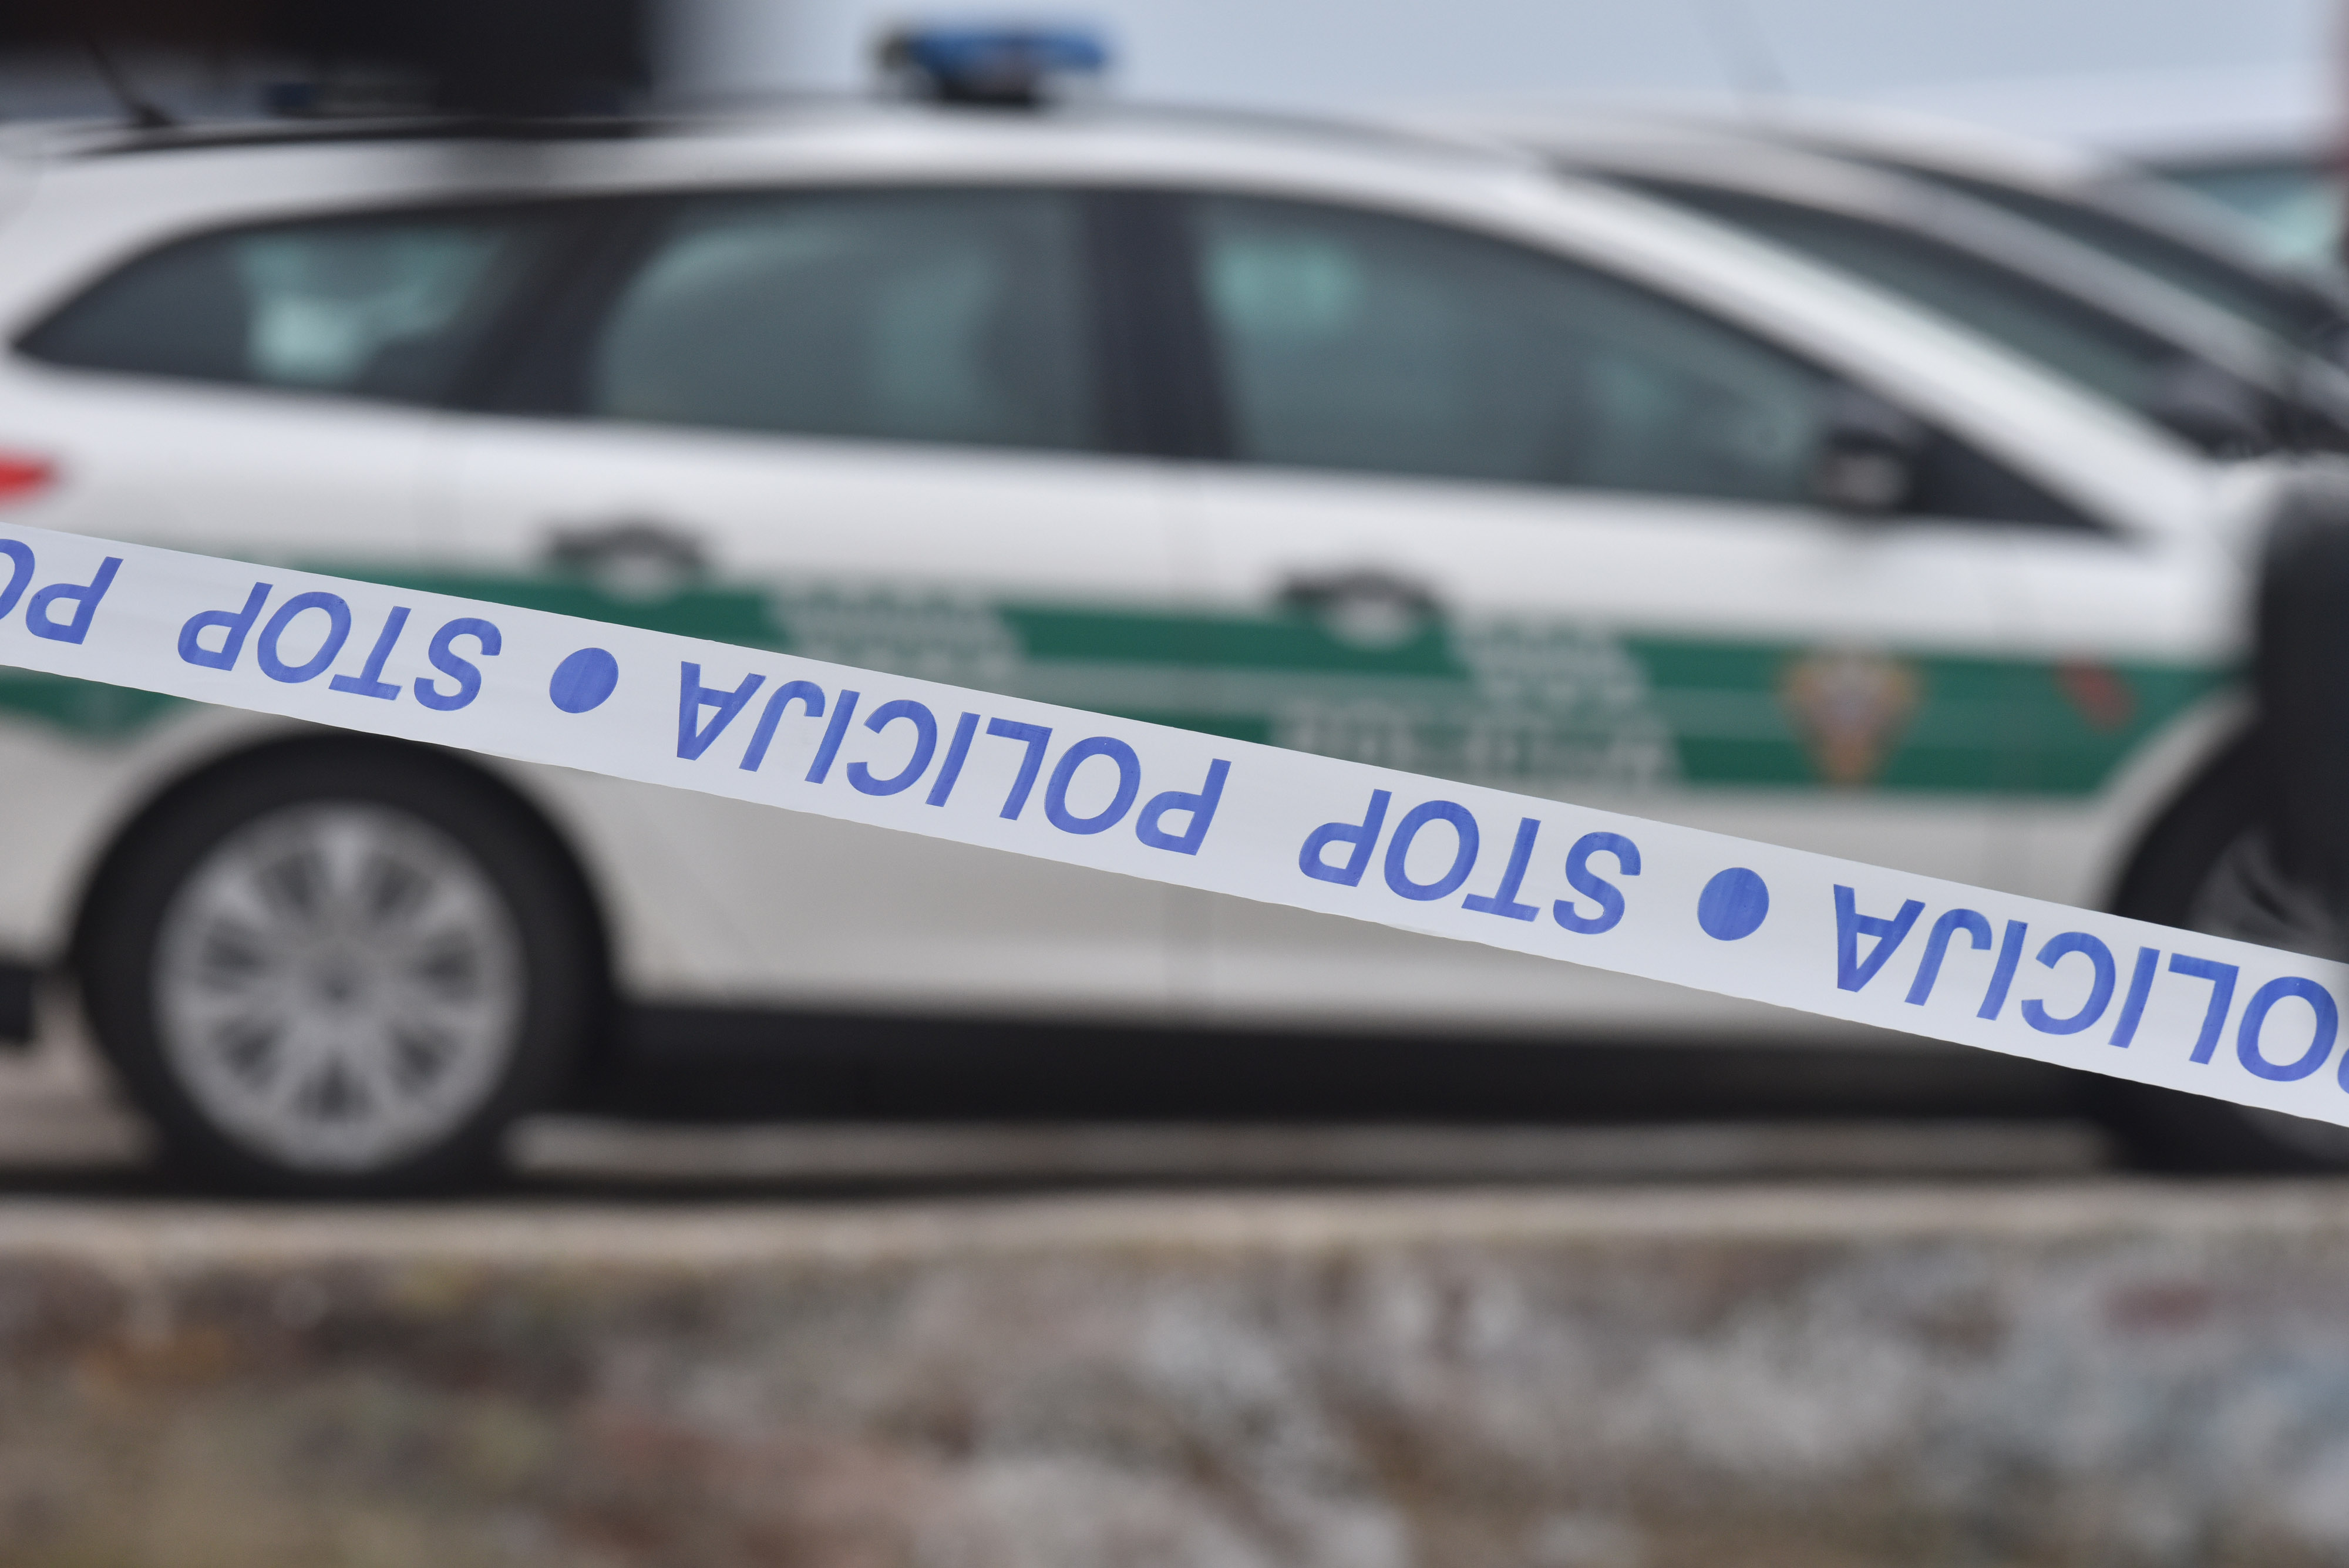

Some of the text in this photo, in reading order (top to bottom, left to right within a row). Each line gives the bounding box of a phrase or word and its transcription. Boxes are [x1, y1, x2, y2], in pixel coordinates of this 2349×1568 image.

[178, 582, 502, 711] STOP
[678, 662, 1231, 856] POLICIJA
[1300, 790, 1641, 934] STOP
[1834, 885, 2349, 1093] OLICIJA
